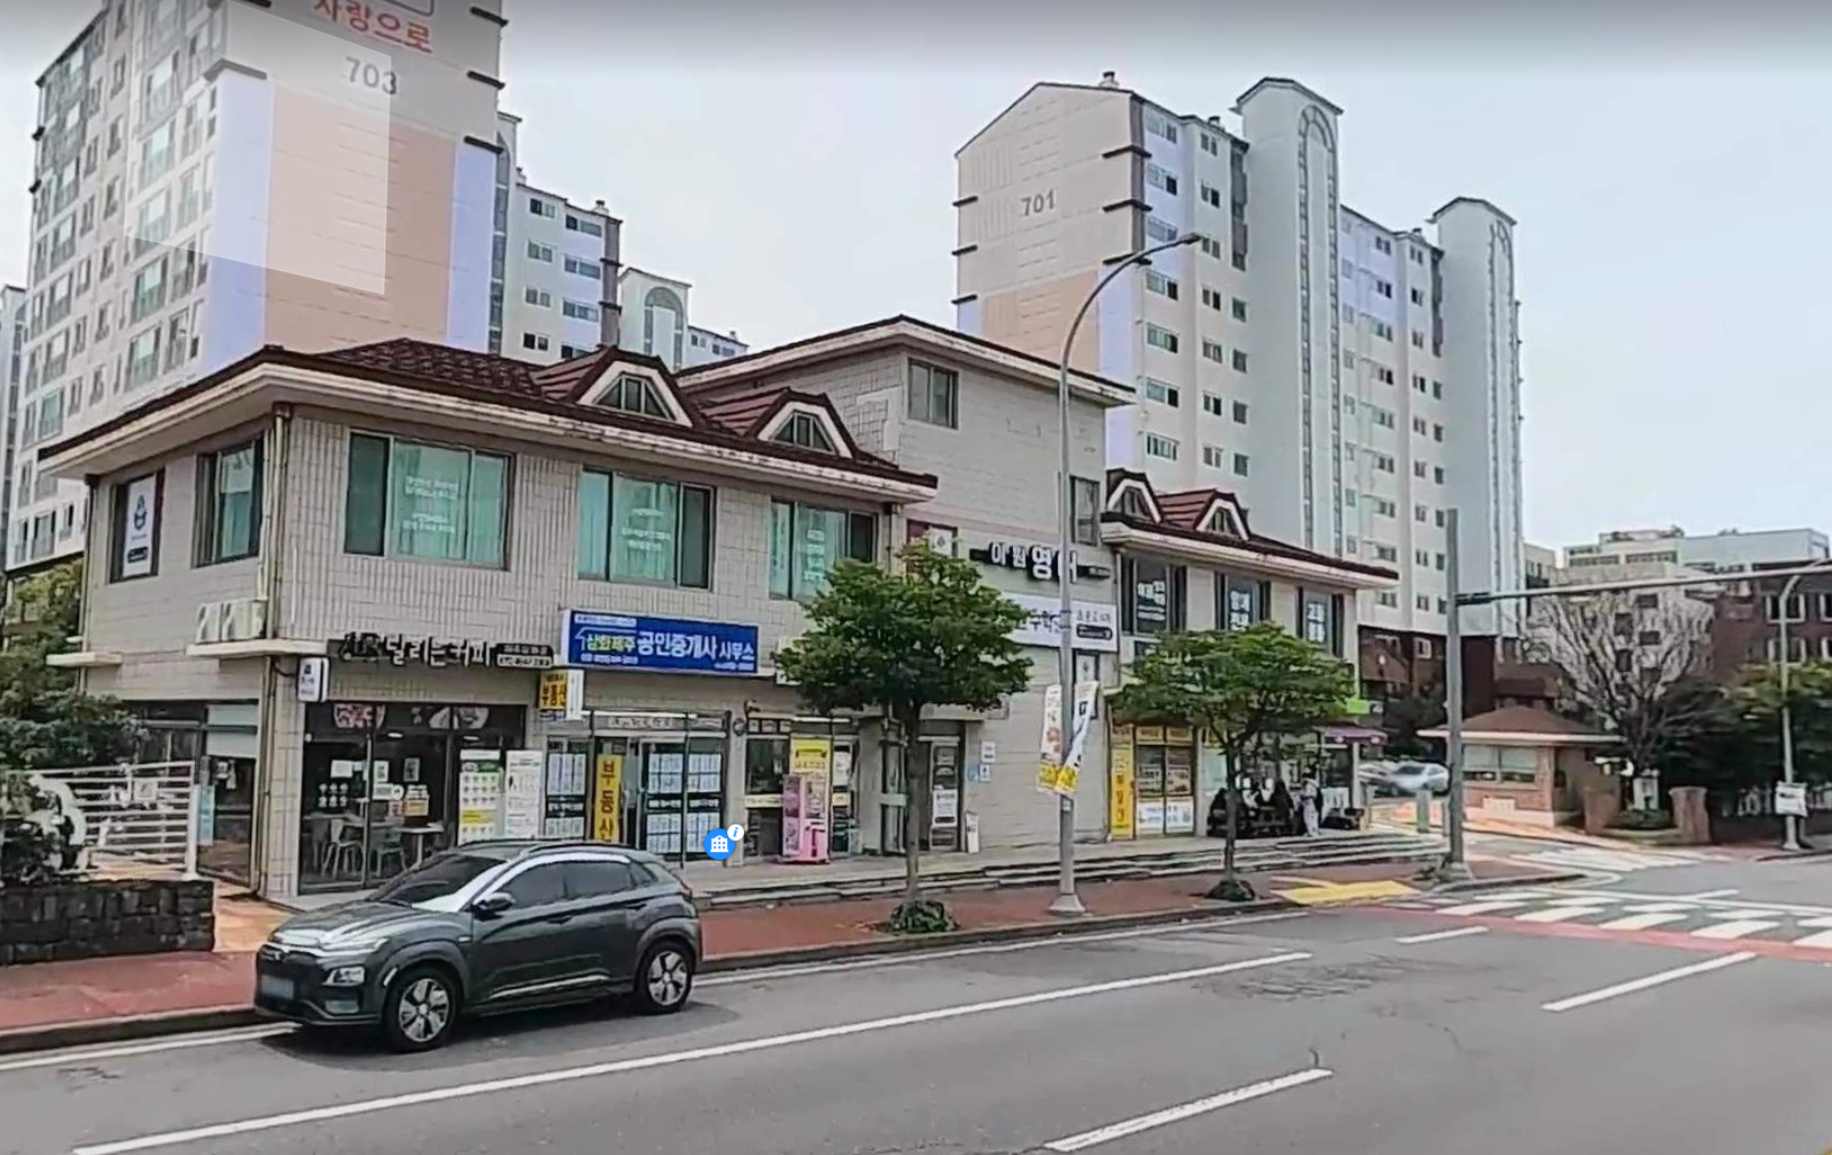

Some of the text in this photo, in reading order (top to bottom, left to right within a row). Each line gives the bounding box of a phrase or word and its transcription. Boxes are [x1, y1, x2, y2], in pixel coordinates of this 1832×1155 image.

[313, 0, 432, 54] 사랑으로
[345, 56, 397, 95] 703
[1020, 189, 1055, 217] 701
[636, 630, 718, 660] 공인중개사
